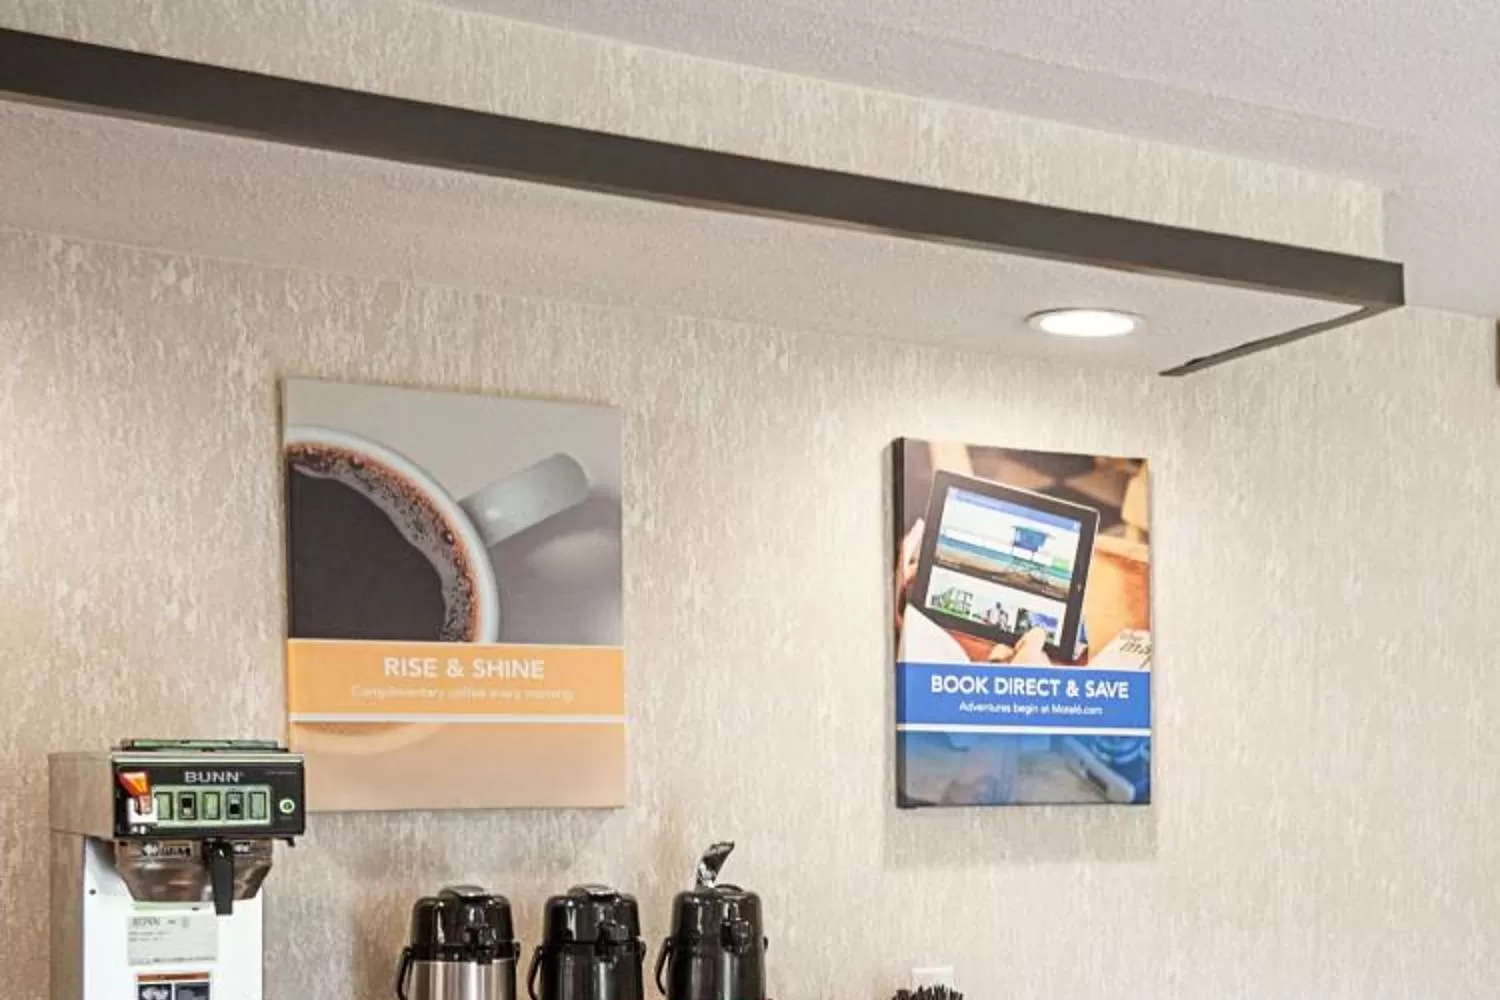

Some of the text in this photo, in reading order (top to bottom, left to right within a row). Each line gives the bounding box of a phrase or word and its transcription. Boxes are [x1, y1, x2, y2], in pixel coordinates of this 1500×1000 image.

[384, 657, 545, 679] RISE & SHINE
[931, 675, 1129, 699] BOOK DIRECT & SAVE
[959, 701, 1011, 713] Adventures
[1013, 703, 1038, 716] begin
[184, 771, 240, 783] BUNN
